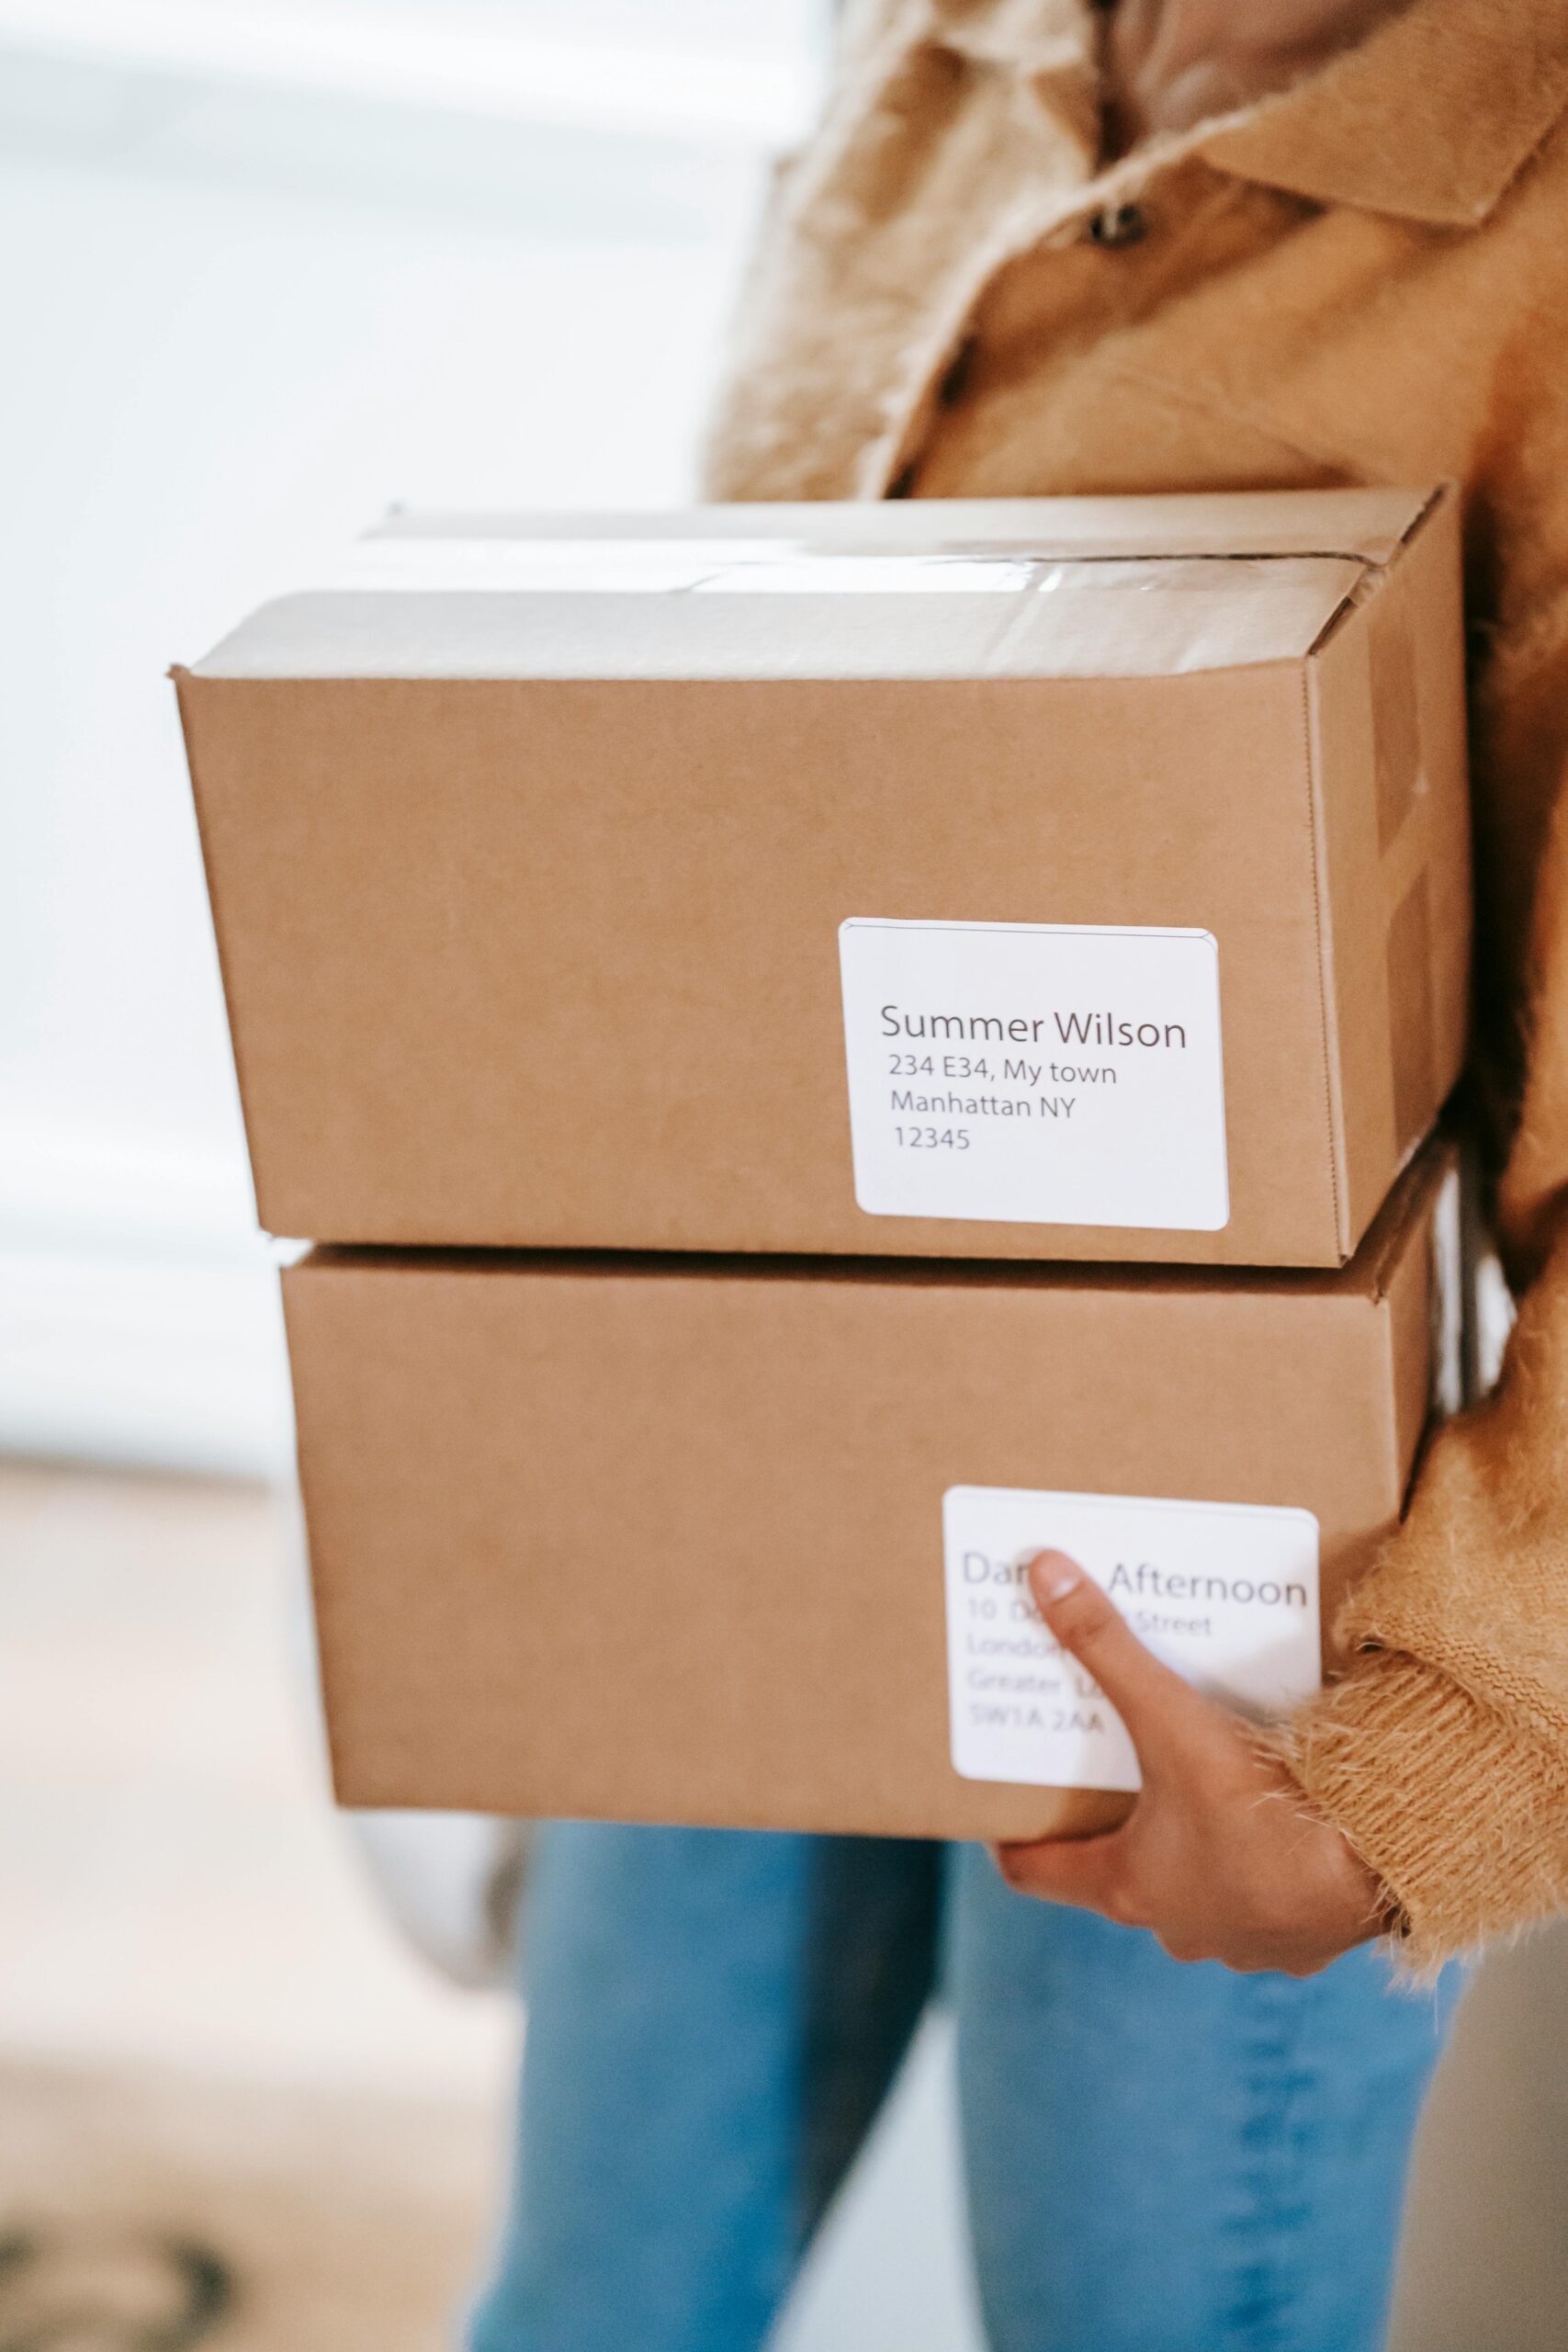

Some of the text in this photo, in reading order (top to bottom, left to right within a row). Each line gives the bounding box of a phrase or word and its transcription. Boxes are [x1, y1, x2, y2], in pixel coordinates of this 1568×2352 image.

[881, 1005, 1187, 1048] Summer Wilson
[888, 1054, 1117, 1086] 234 E34, My town
[891, 1090, 1076, 1118] Manhattan NY
[895, 1126, 970, 1149] 12345
[1109, 1562, 1307, 1607] Afternoon
[968, 1597, 998, 1621] 10
[1136, 1611, 1212, 1637] Street
[968, 1666, 1061, 1694] Greater
[1053, 1708, 1106, 1735] 2AA
